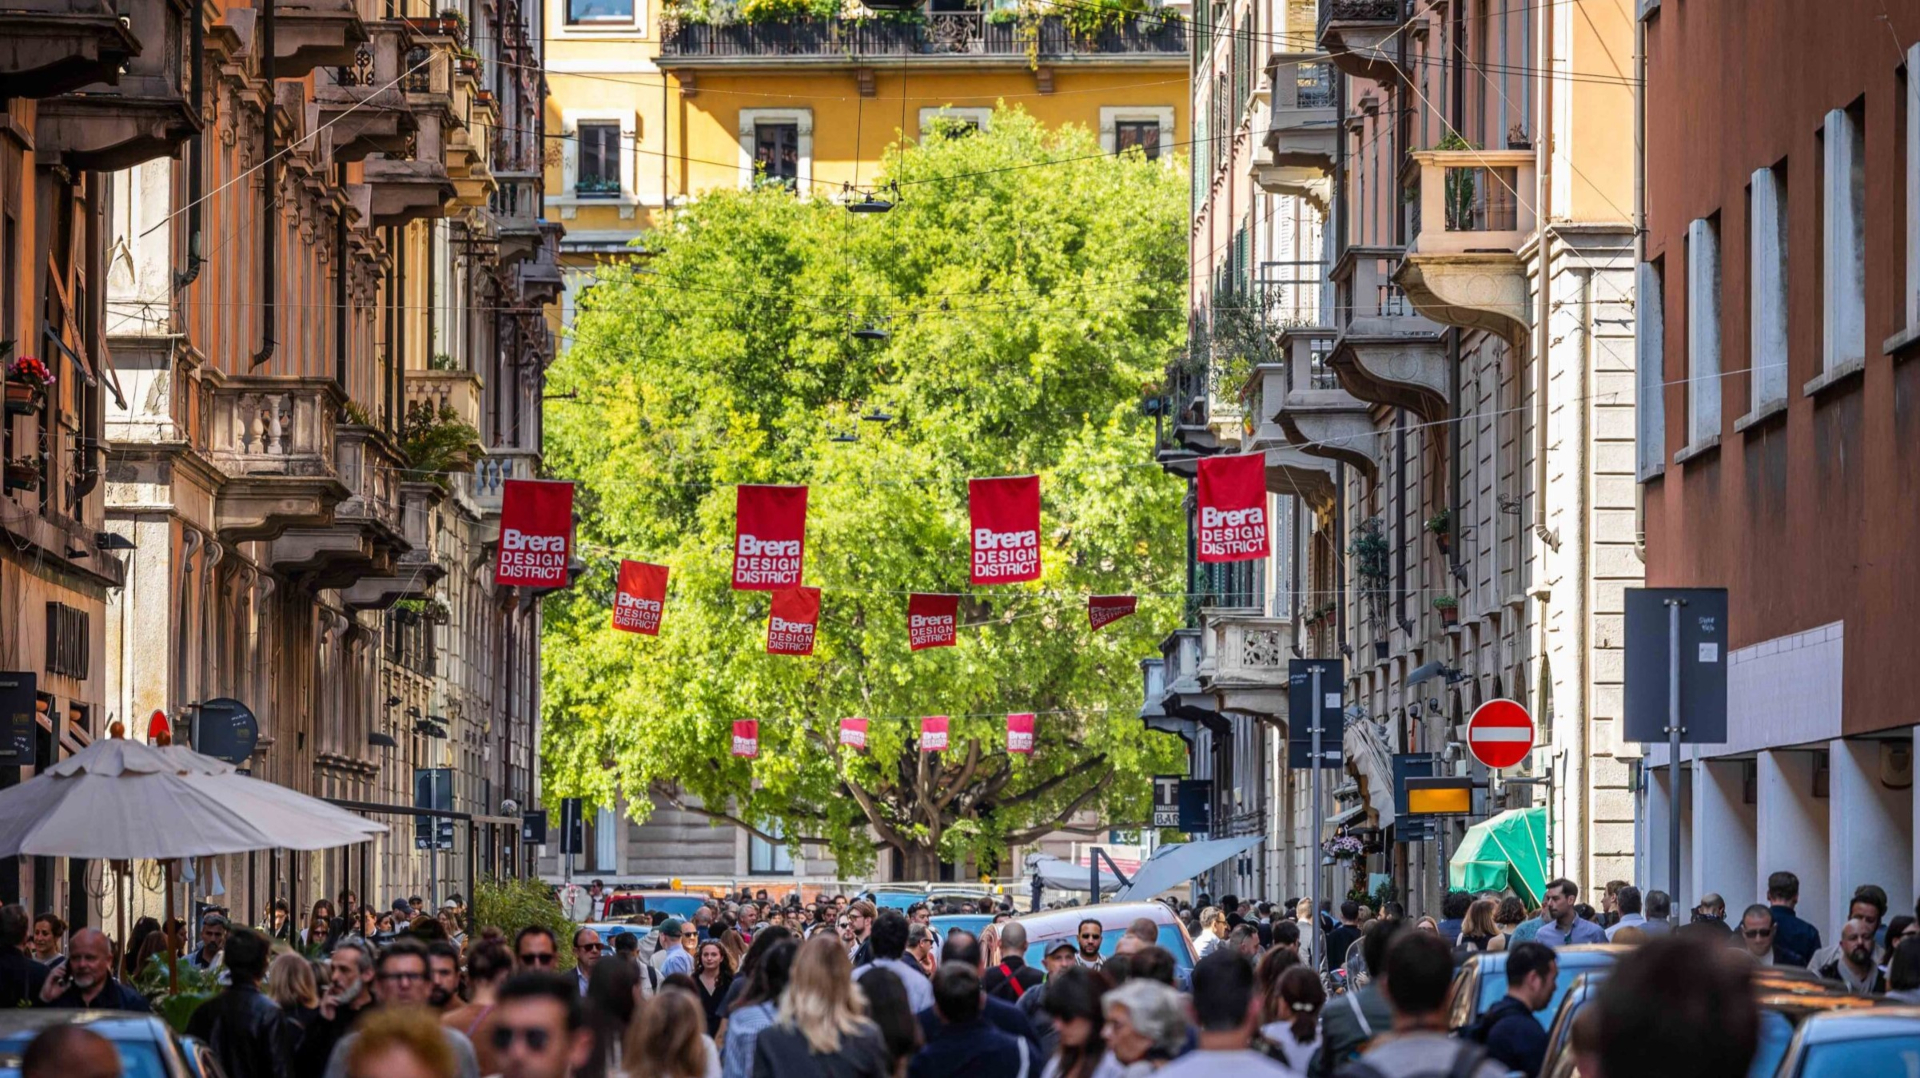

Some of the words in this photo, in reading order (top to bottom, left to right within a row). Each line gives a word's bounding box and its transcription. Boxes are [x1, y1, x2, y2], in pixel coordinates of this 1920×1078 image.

[1202, 506, 1263, 528] Brera
[503, 528, 565, 552] Brera
[975, 528, 1036, 549] Brera
[1202, 525, 1264, 542] DESIGN
[738, 534, 800, 557] Brera
[1202, 538, 1264, 555] DISTRICT
[501, 552, 564, 566] DESIGN
[975, 548, 1037, 563] DESIGN
[737, 557, 799, 570] DESIGN
[975, 560, 1037, 577] DISTRICT
[500, 565, 563, 579] DISTRICT
[736, 570, 798, 583] DISTRICT
[618, 592, 660, 612] Brera
[616, 607, 660, 621] DESIGN
[911, 614, 952, 627] Brera
[614, 615, 657, 630] DISTRICT
[771, 616, 813, 634] Brera
[770, 631, 813, 643] DESIGN
[911, 625, 953, 637] DESIGN
[769, 640, 811, 651] DISTRICT
[912, 633, 952, 645] DISTRICT
